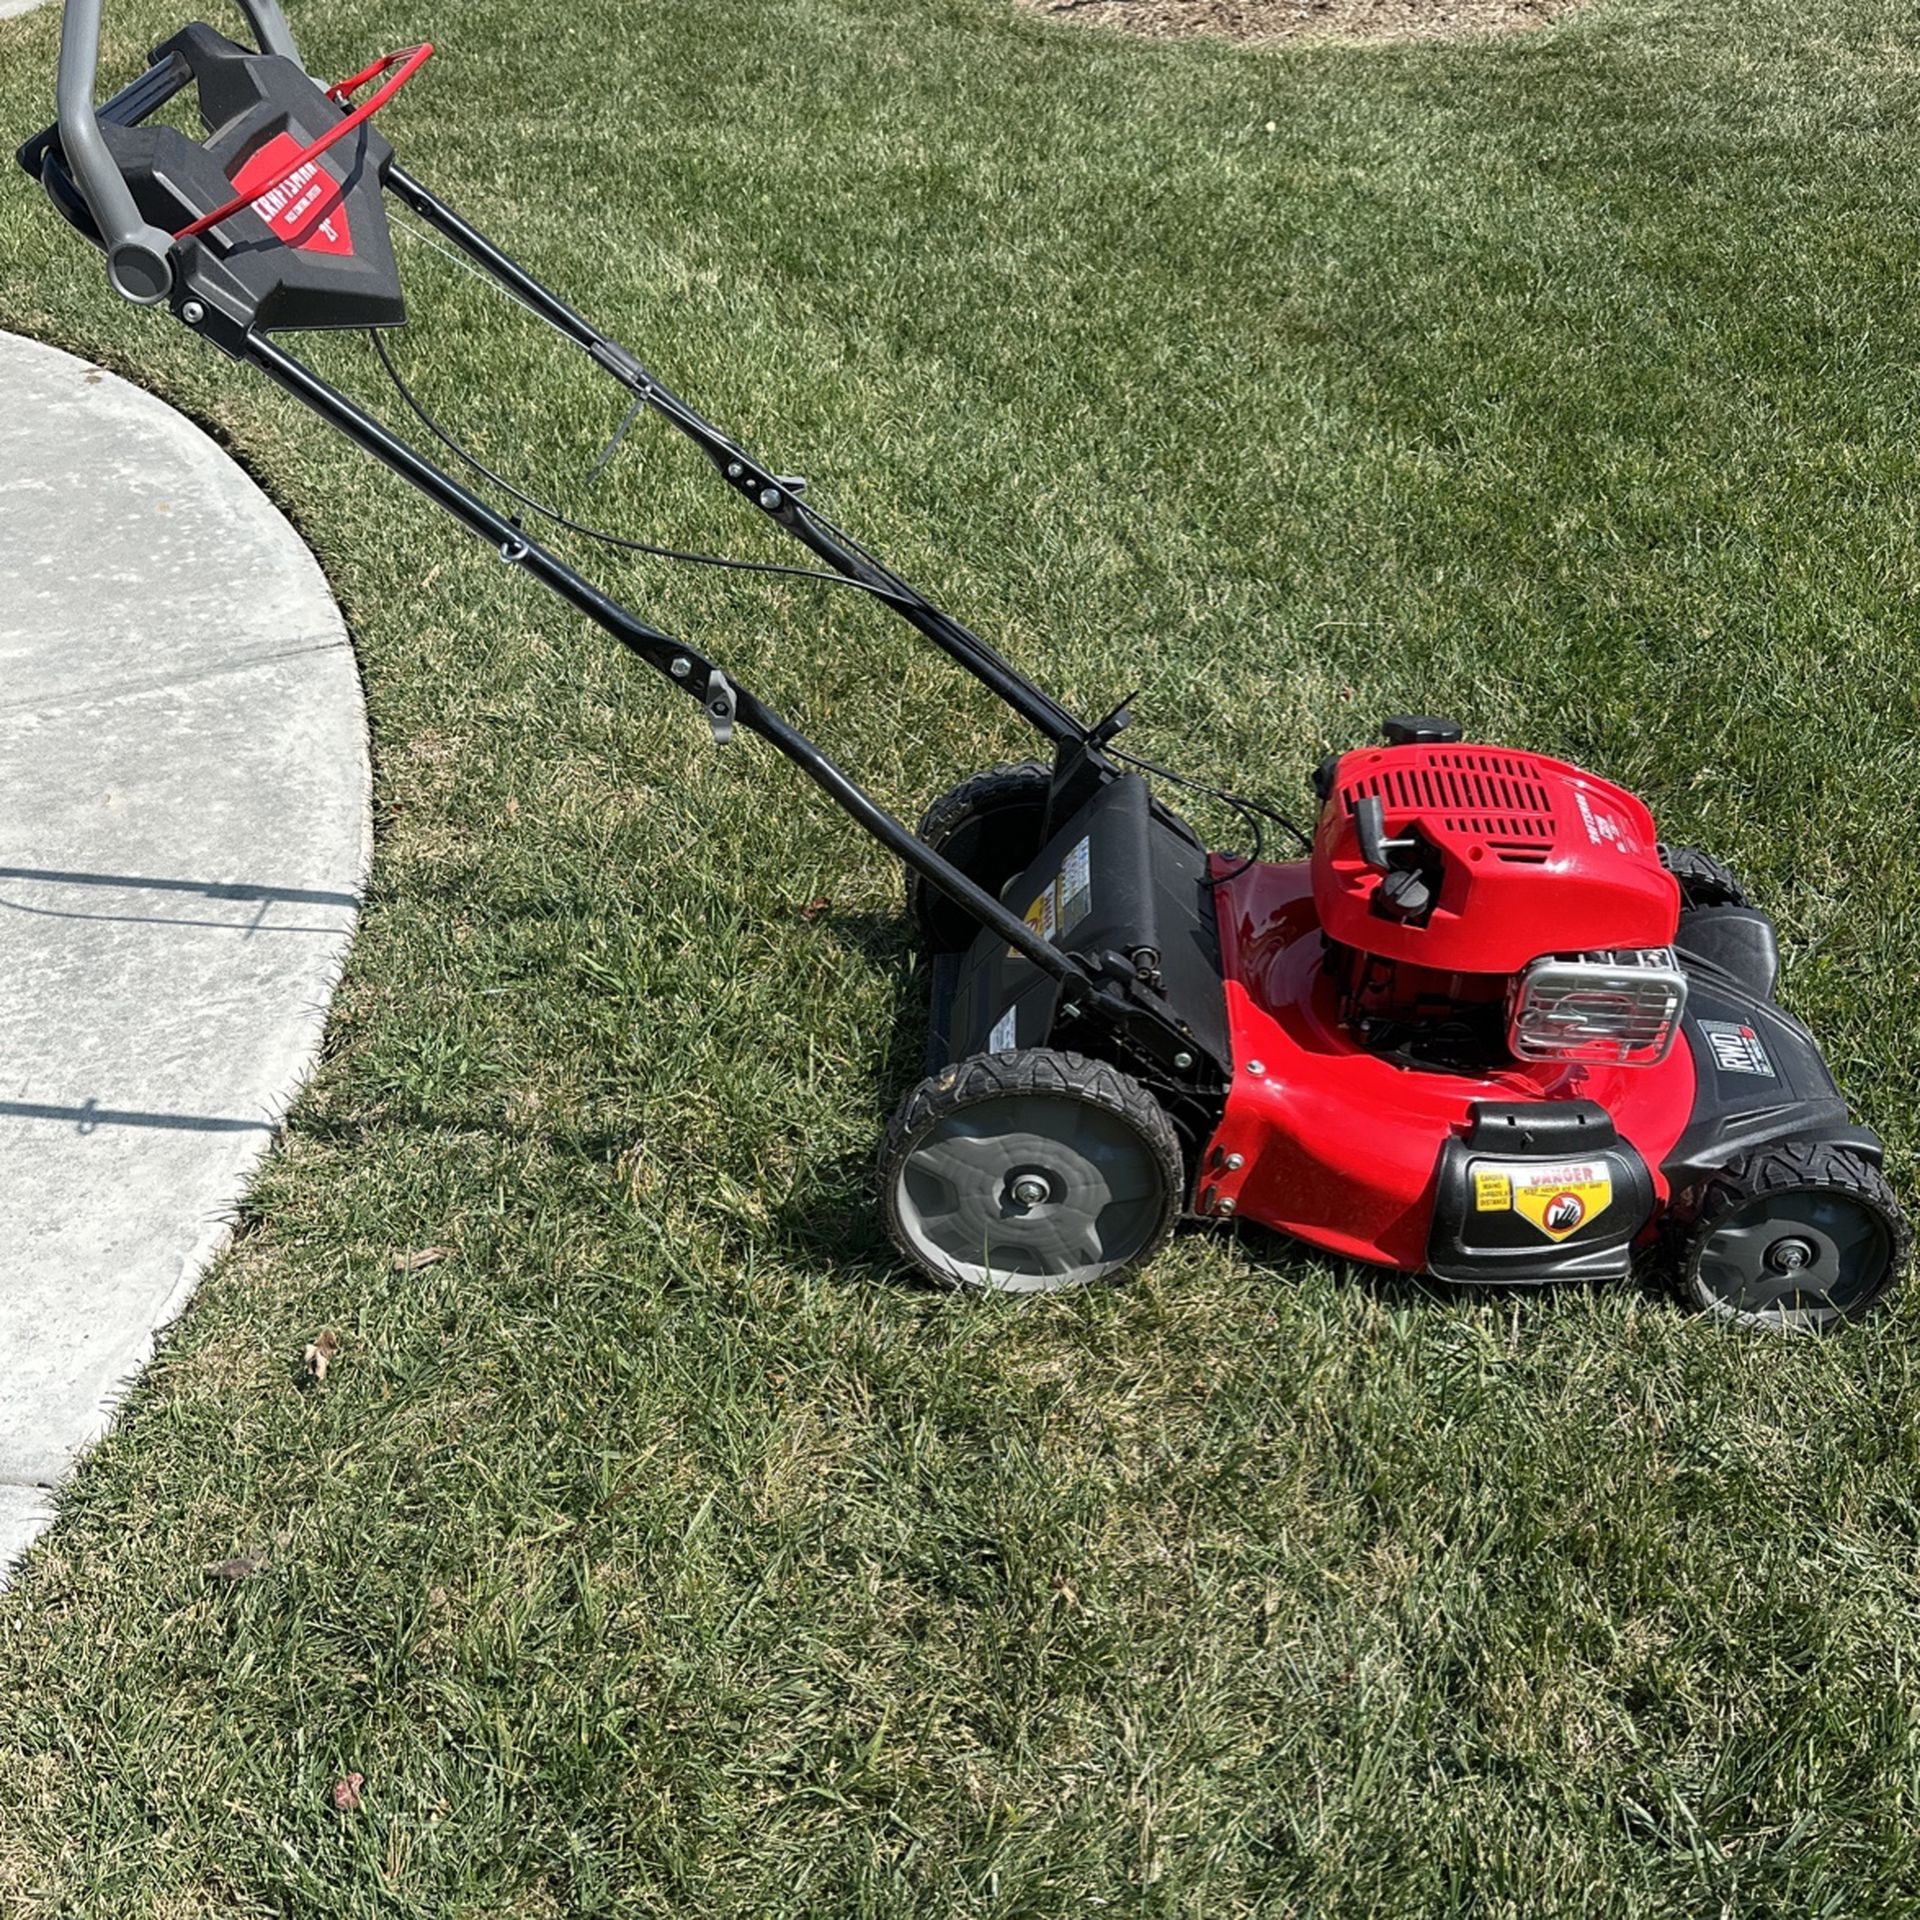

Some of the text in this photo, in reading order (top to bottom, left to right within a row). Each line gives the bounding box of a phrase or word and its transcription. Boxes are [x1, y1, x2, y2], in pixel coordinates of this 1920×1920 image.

[251, 161, 318, 223] CRAFTSMAN
[1710, 1033, 1756, 1071] RWD
[1530, 1166, 1594, 1186] DANGER
